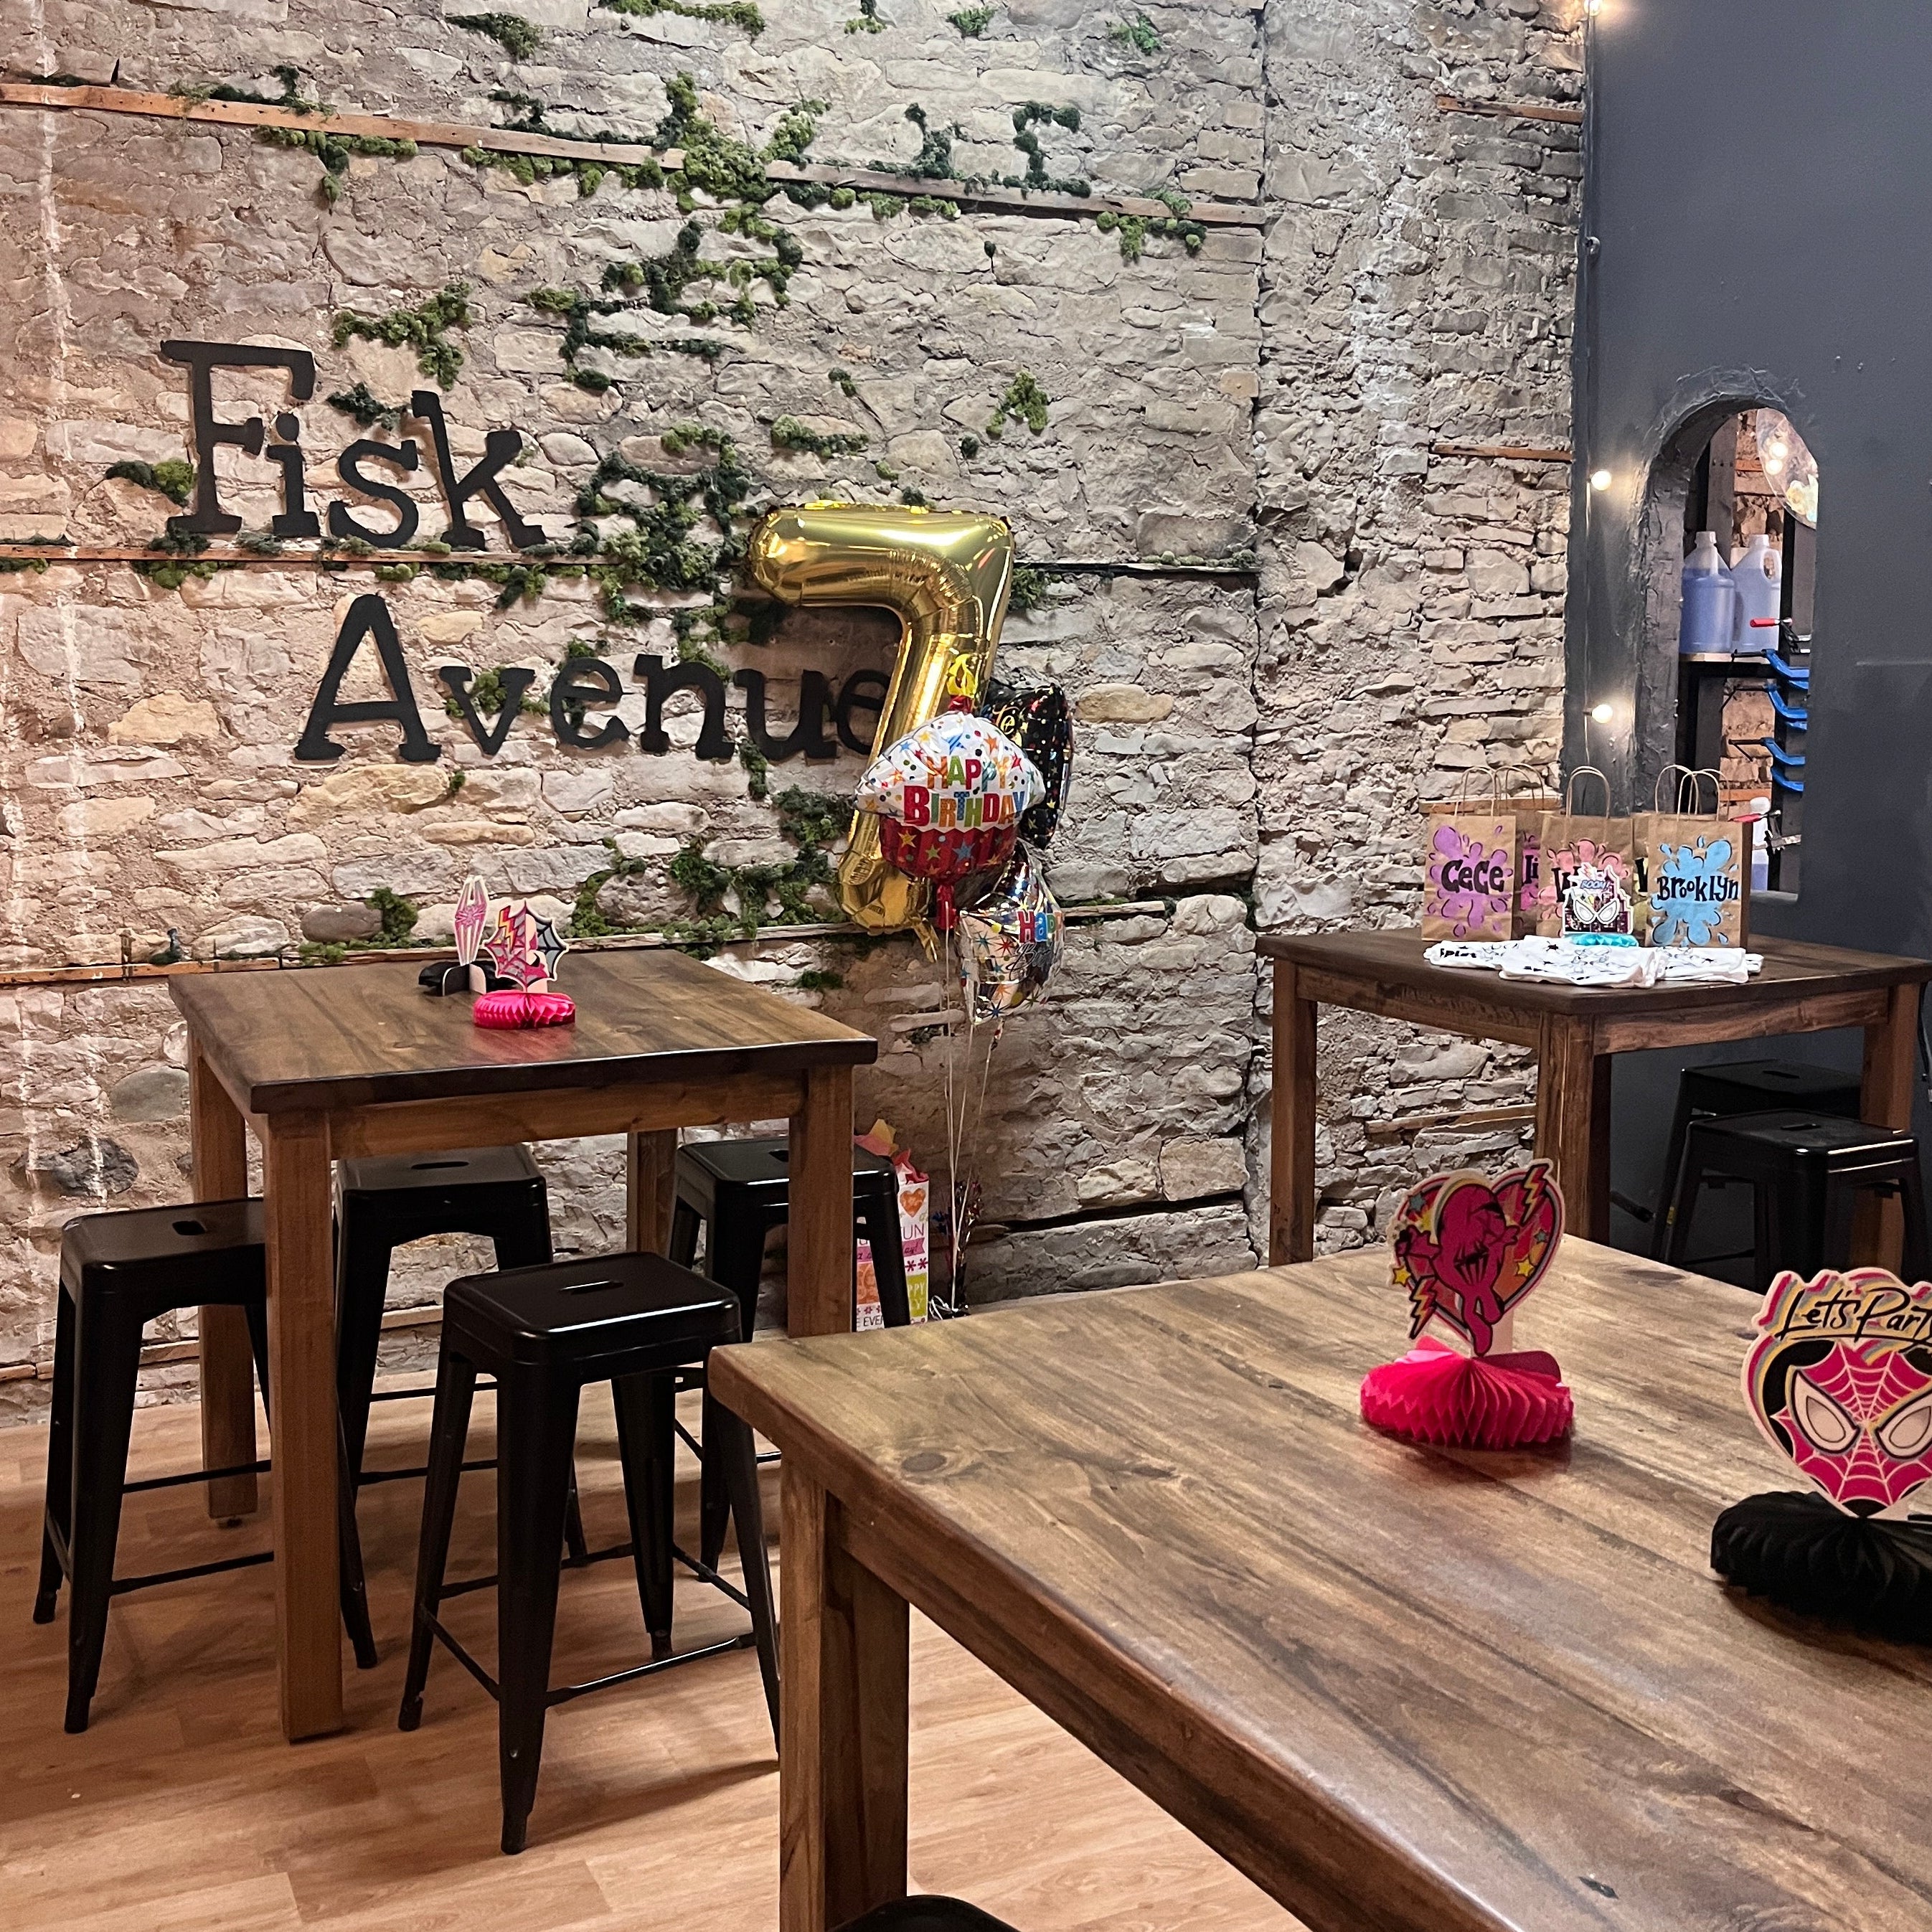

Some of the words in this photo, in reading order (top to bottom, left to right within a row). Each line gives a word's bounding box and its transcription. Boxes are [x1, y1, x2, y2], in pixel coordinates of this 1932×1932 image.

[161, 339, 547, 551] Fisk
[294, 593, 891, 761] Avenue
[926, 755, 1010, 792] HAPPY
[904, 785, 1025, 827] BIRTHDAY
[1656, 875, 1739, 903] Brooklyn
[901, 1223, 925, 1240] UN
[1774, 1288, 1862, 1342] Let's
